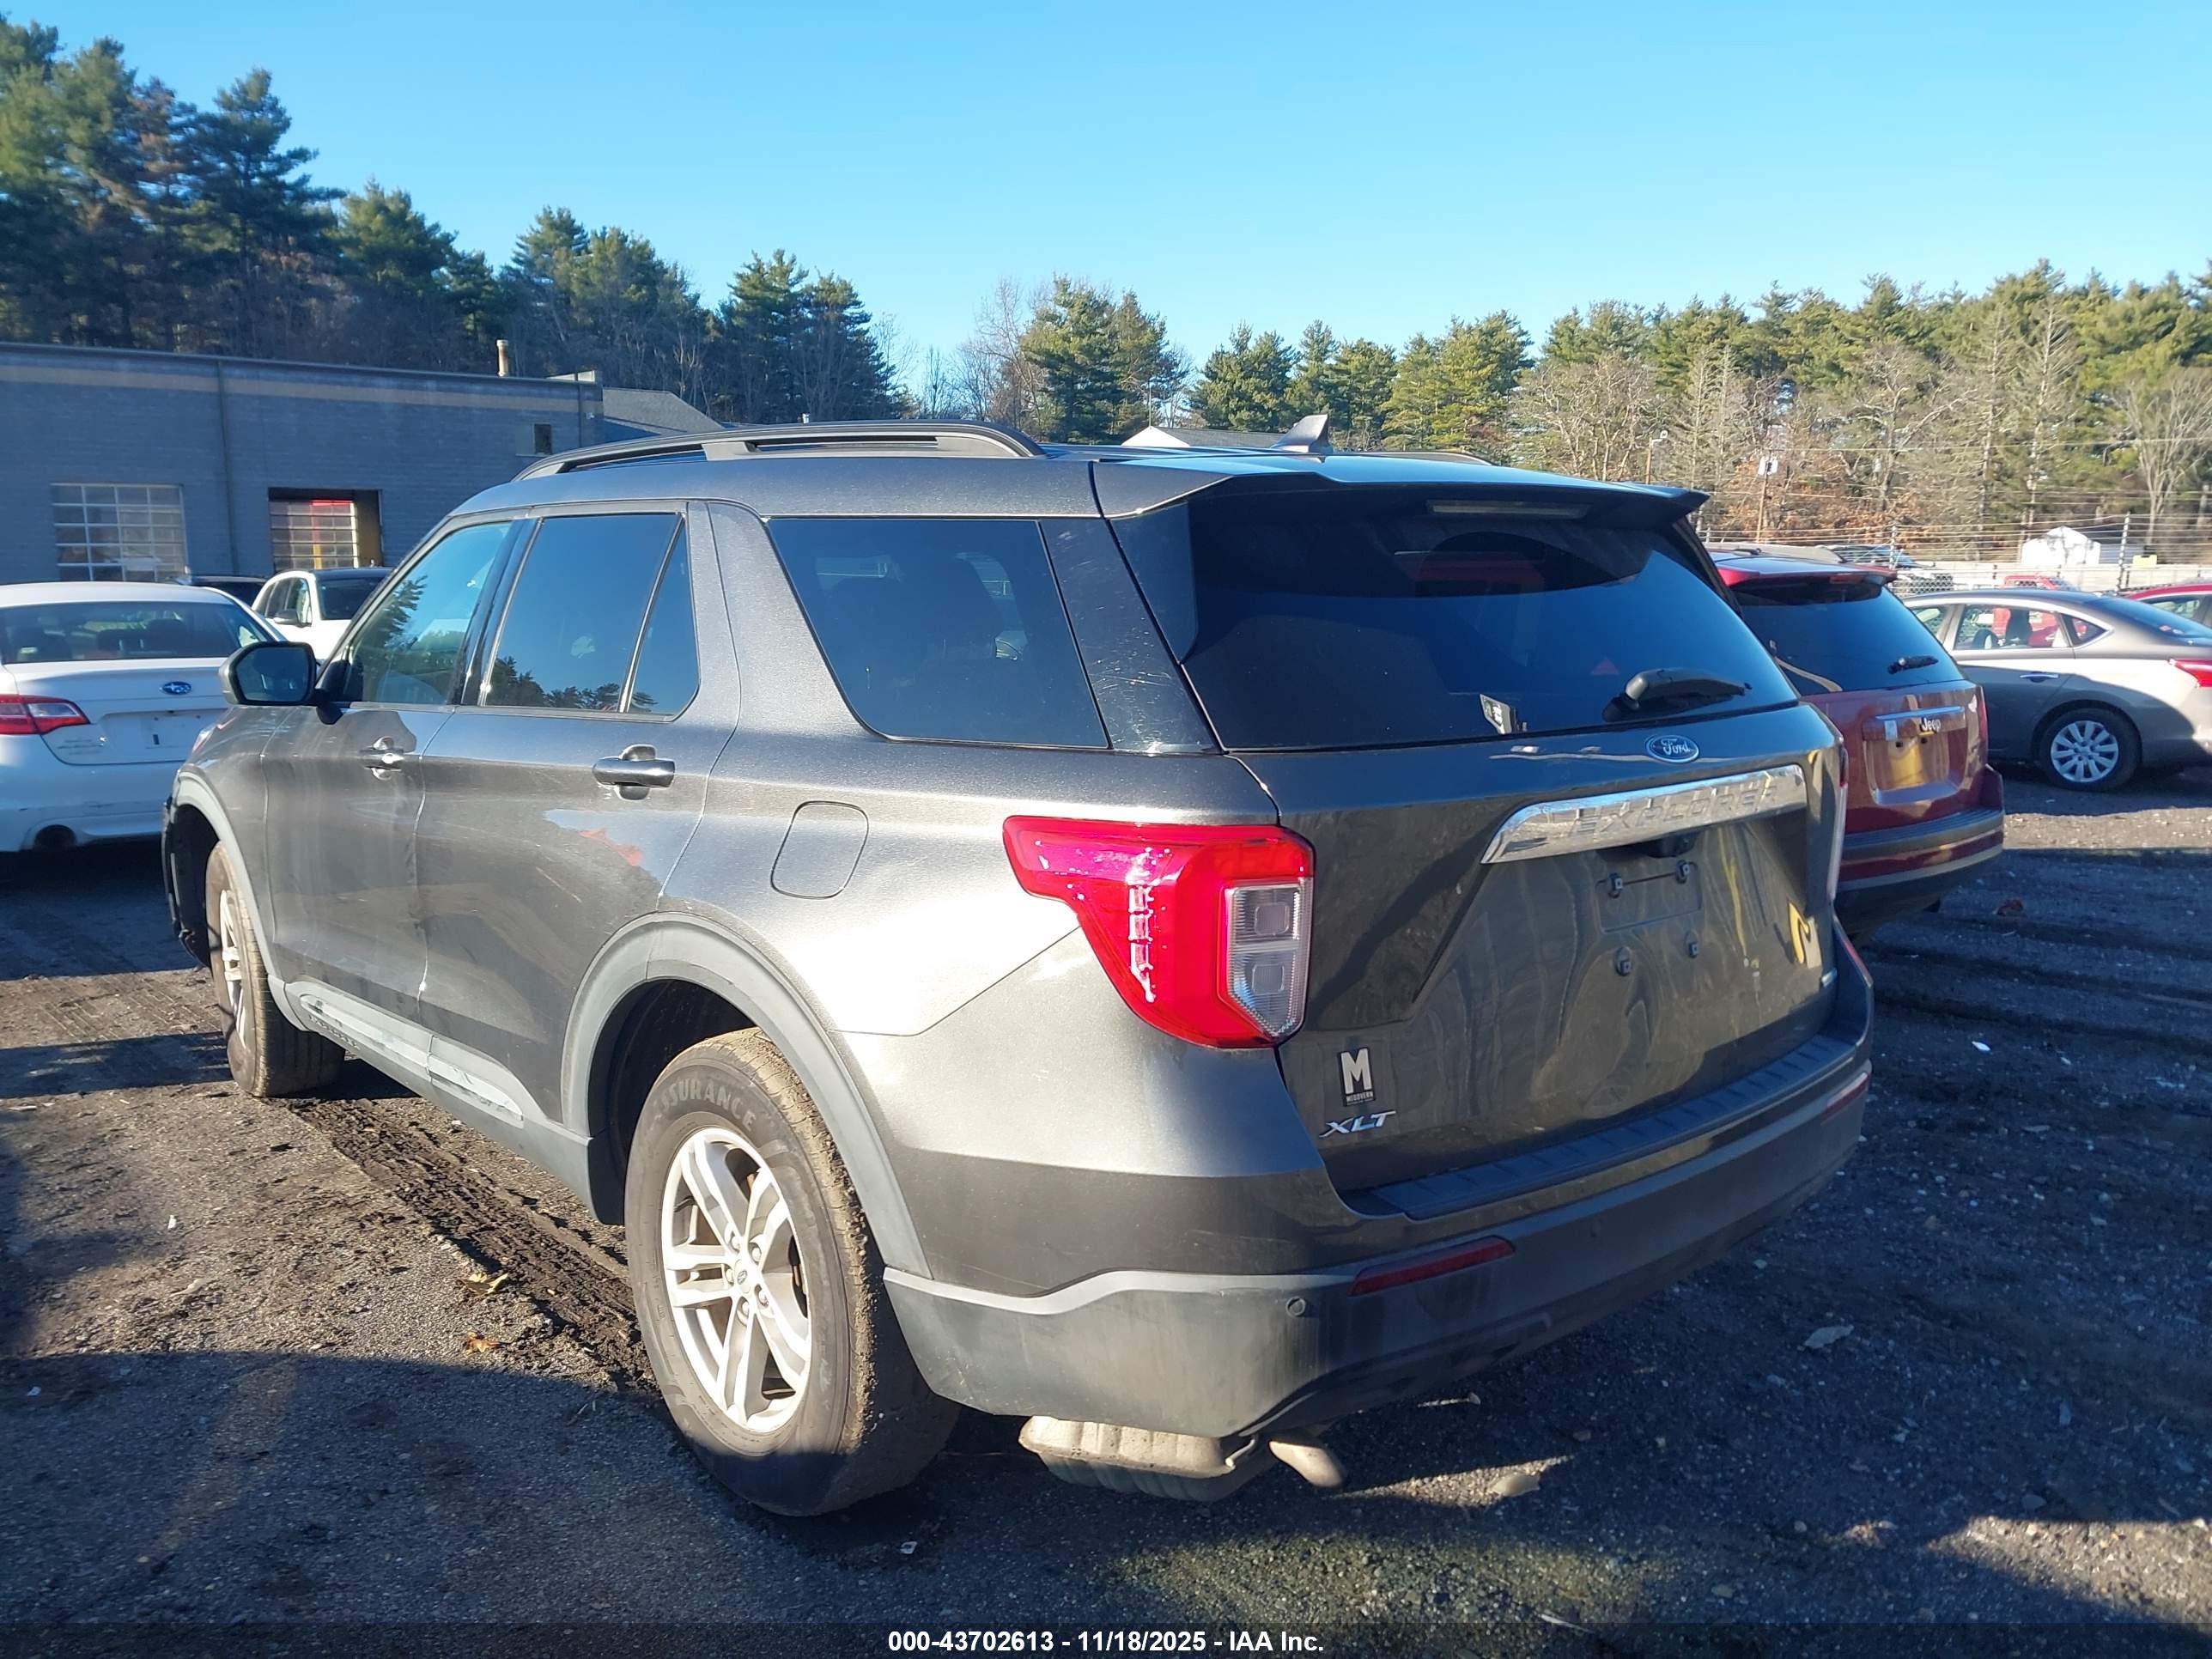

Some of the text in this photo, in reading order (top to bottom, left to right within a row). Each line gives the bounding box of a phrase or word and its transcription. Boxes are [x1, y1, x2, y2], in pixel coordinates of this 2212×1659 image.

[1921, 717, 1942, 732] Jeep
[1660, 737, 1692, 757] Ford
[1571, 782, 1778, 837] EXPLORER
[1340, 1047, 1373, 1095] M
[1319, 1109, 1397, 1138] XLT
